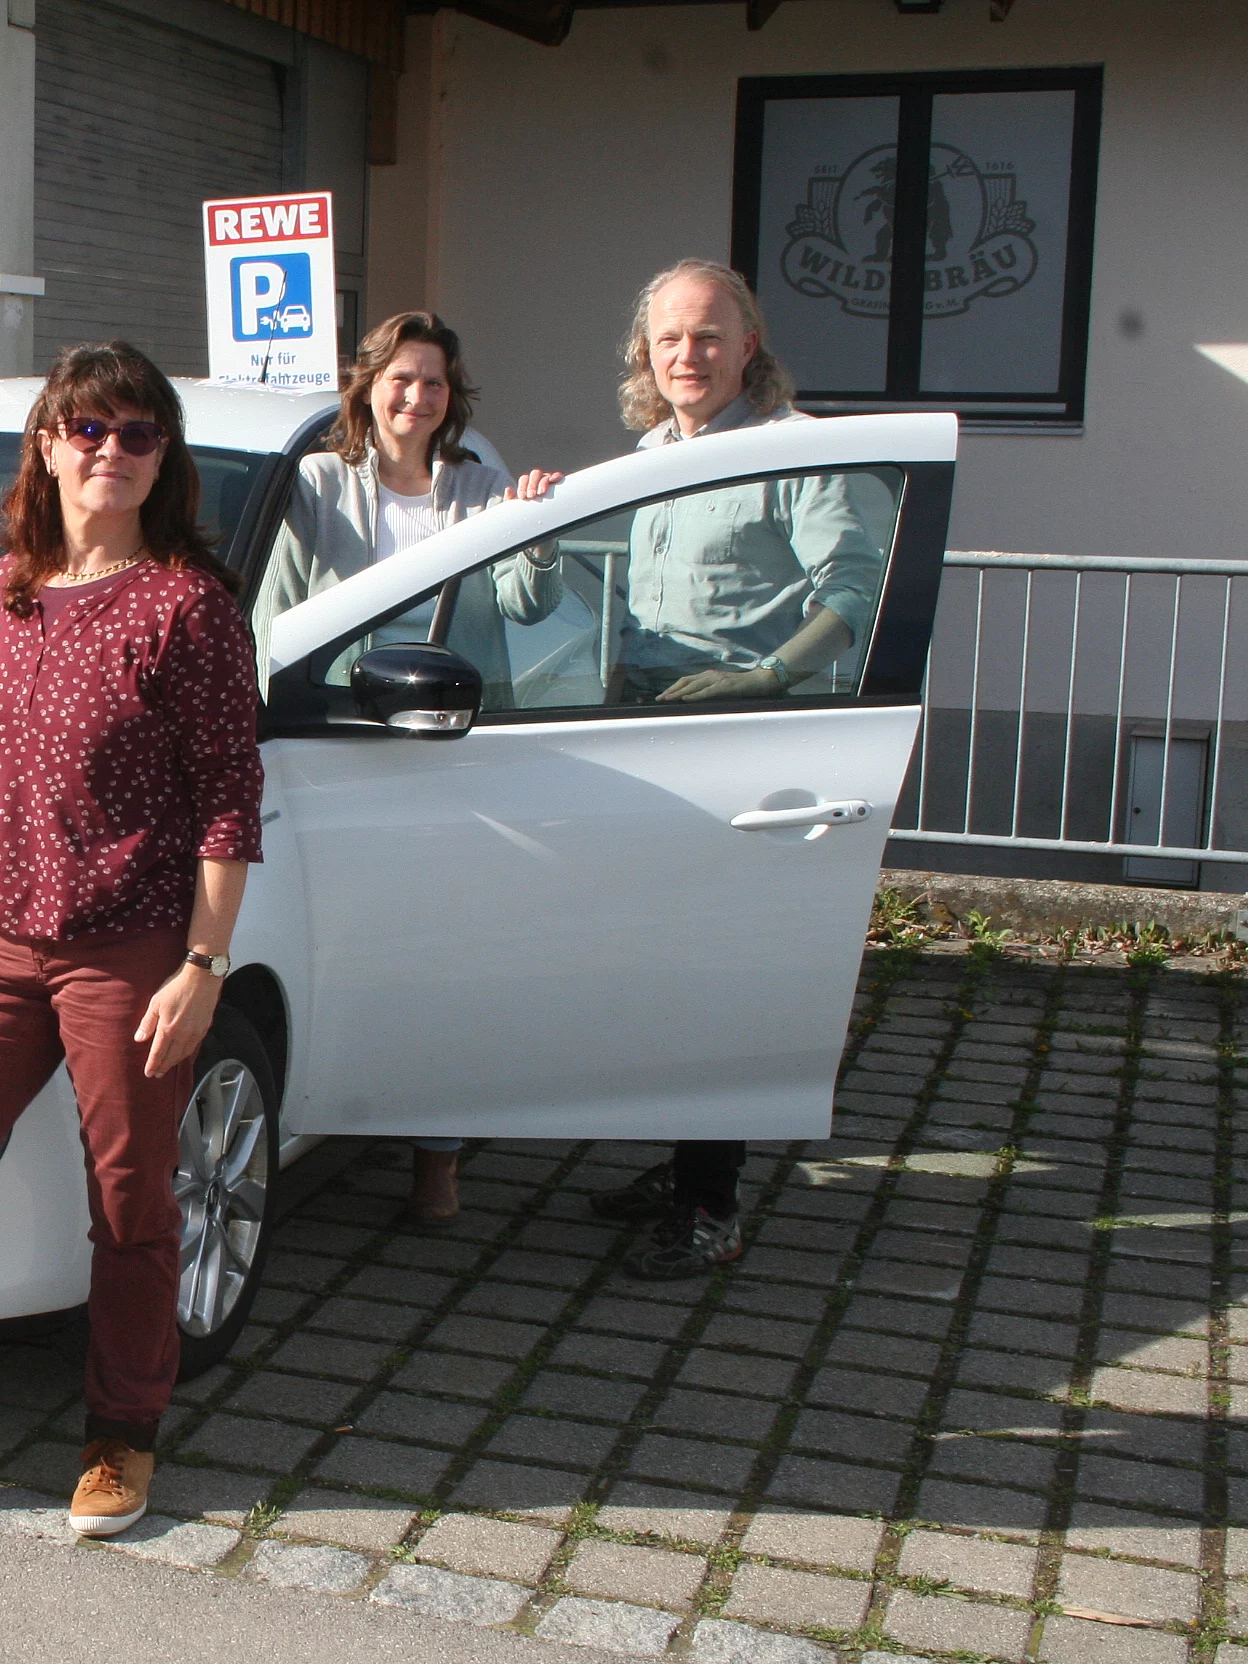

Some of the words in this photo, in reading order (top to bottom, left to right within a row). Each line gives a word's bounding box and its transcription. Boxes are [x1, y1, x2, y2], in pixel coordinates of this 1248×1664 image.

[813, 163, 839, 175] SEIT
[984, 160, 1015, 172] 1616
[214, 203, 322, 240] REWE
[239, 262, 287, 335] P
[250, 354, 274, 367] Nur
[277, 352, 297, 366] für
